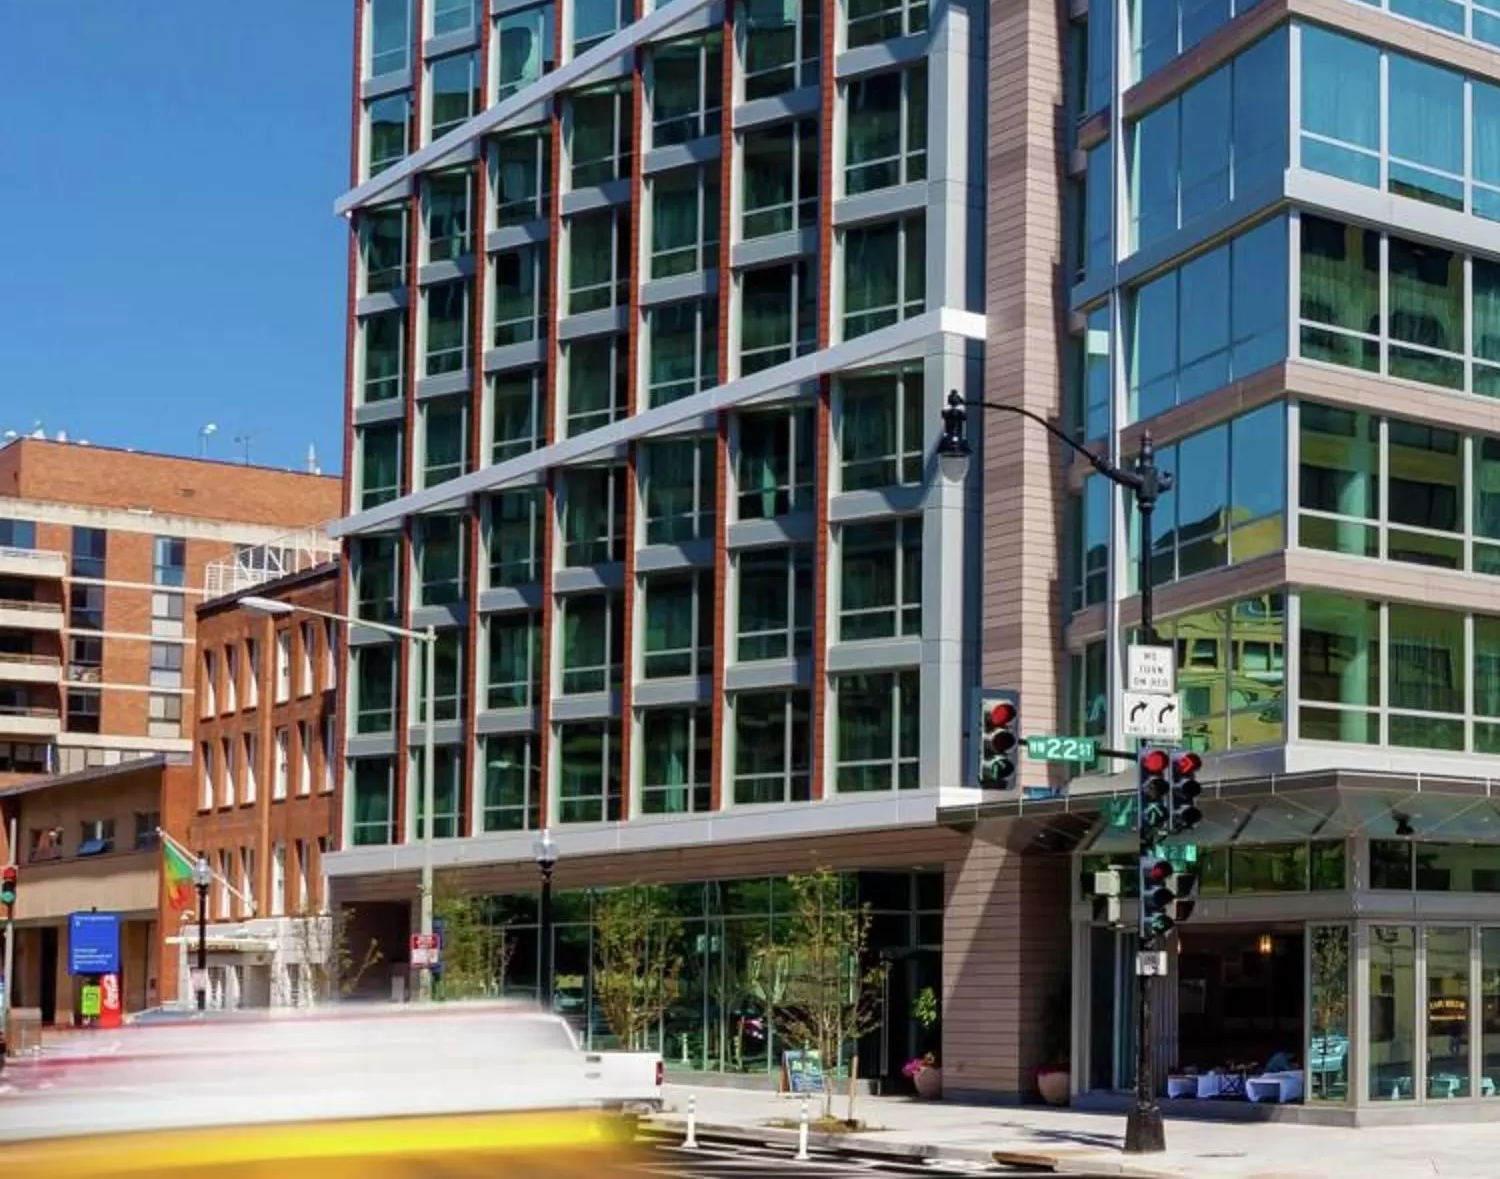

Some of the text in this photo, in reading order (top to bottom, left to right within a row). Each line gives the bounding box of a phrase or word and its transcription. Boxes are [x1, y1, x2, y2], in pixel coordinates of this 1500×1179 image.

[1138, 665, 1164, 674] TURN
[1047, 738, 1078, 760] 22
[1079, 743, 1092, 758] ST
